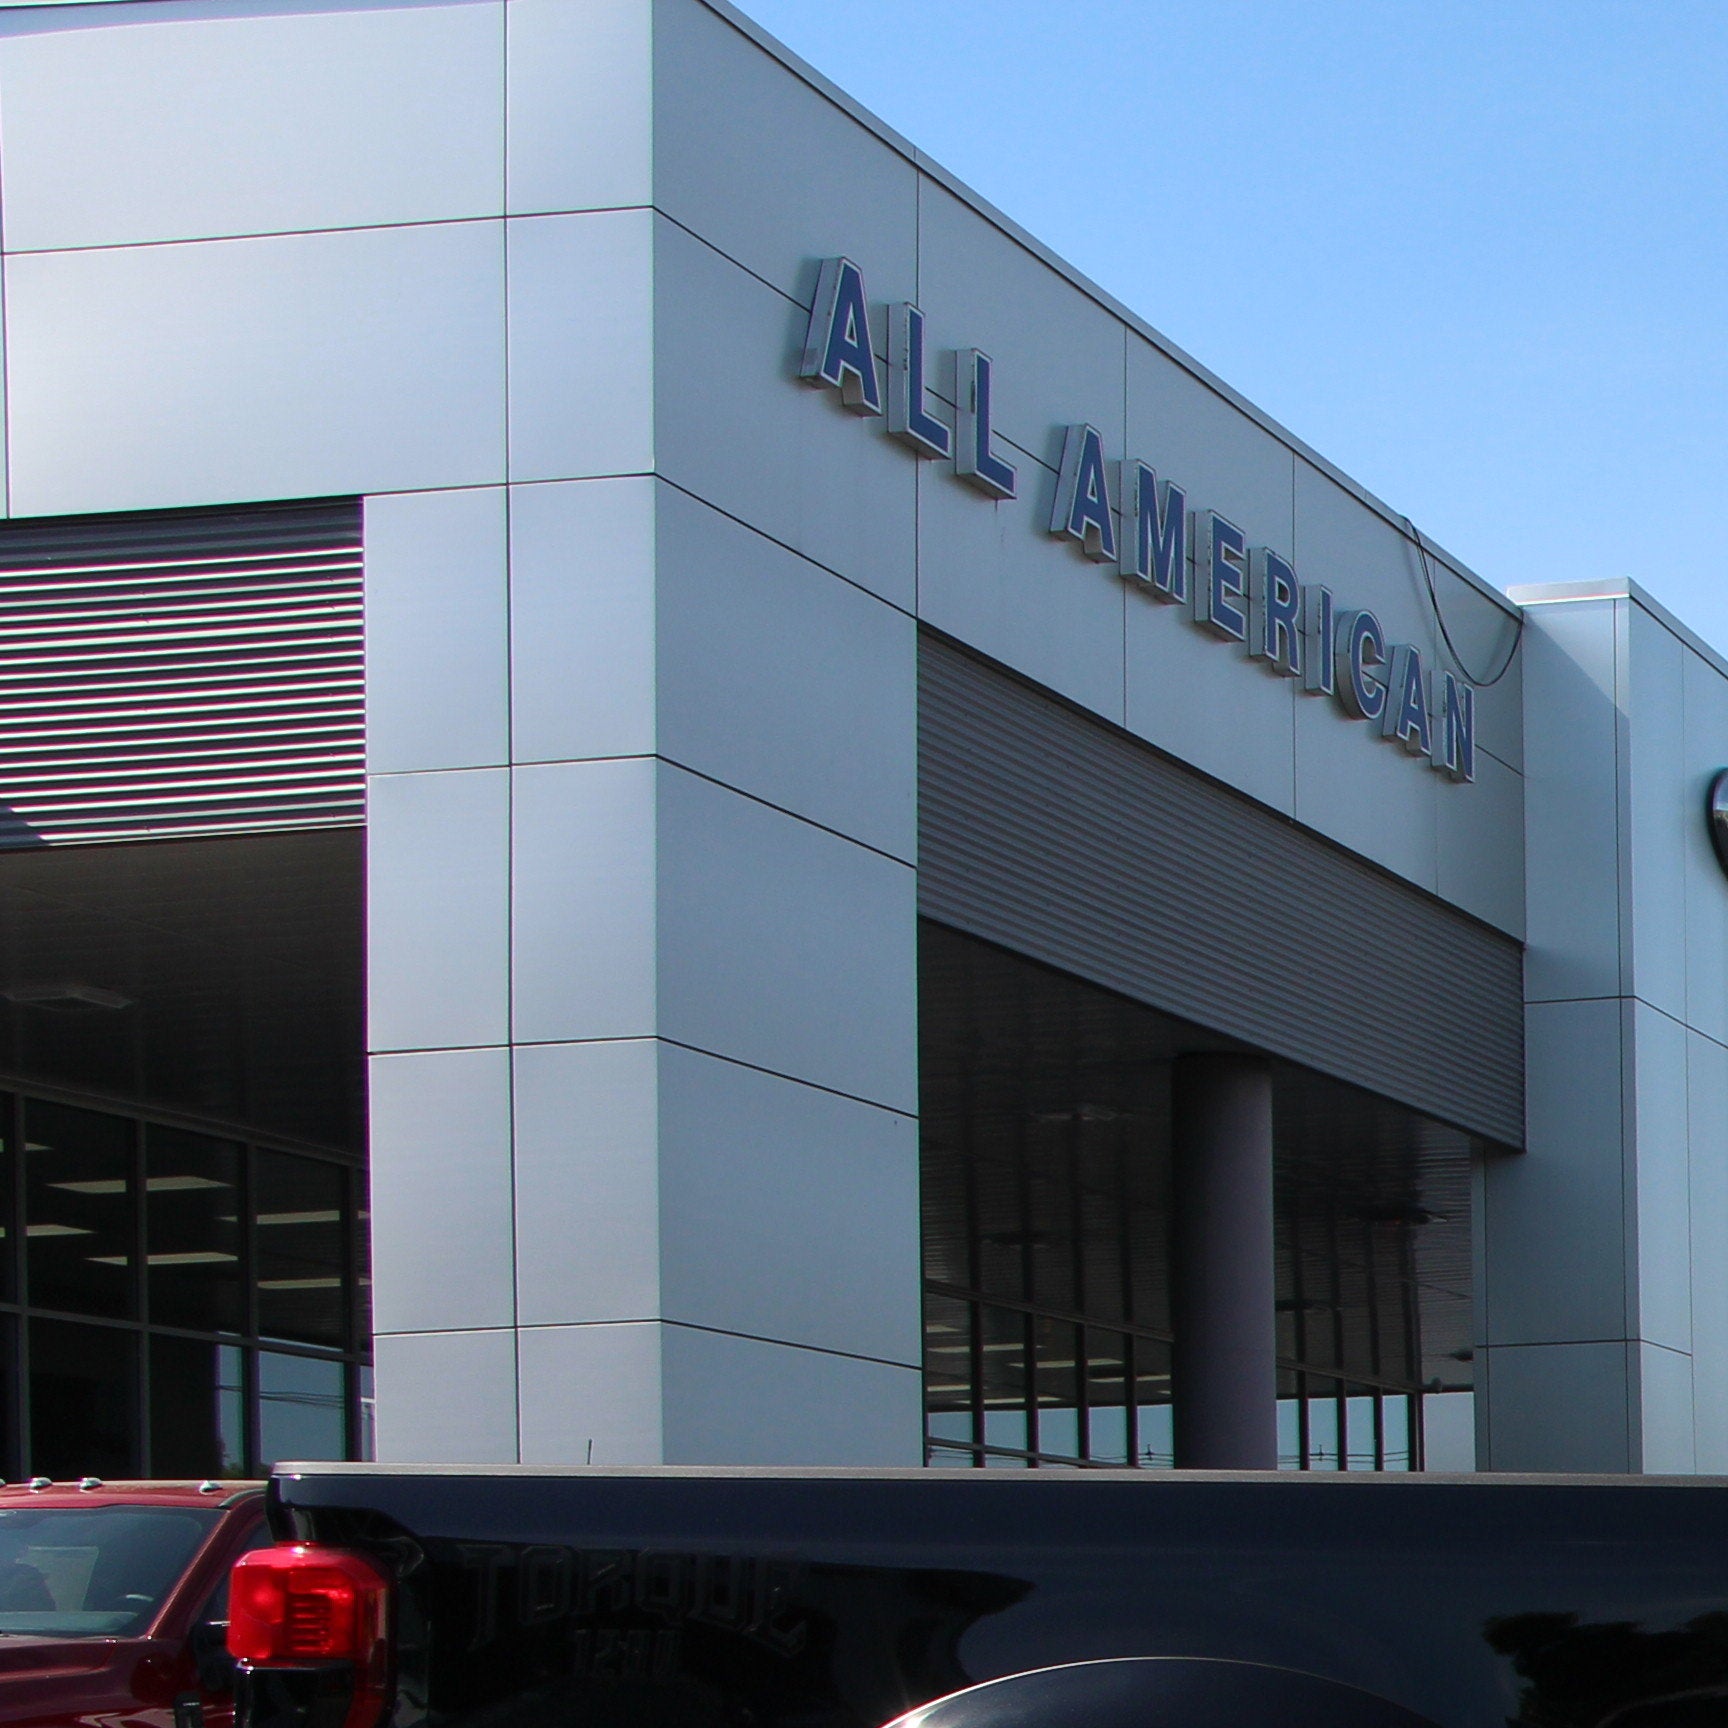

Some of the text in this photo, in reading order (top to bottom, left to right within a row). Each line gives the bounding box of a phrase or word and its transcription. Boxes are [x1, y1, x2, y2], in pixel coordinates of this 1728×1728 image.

[802, 256, 1477, 784] ALL AMERICAN
[455, 1543, 808, 1659] TORQUE
